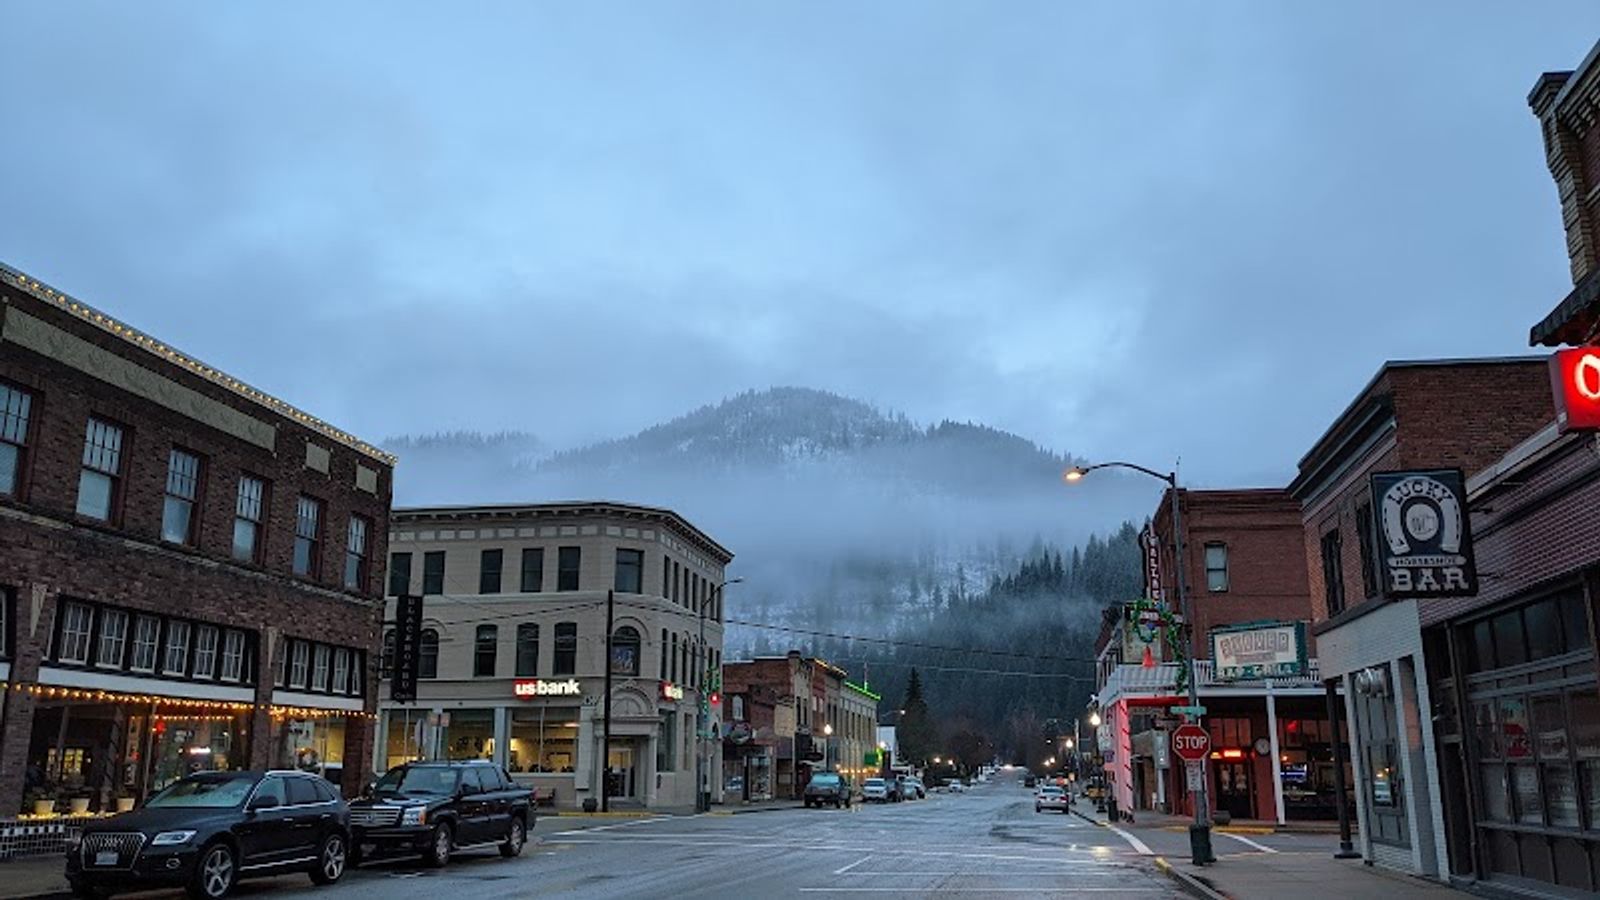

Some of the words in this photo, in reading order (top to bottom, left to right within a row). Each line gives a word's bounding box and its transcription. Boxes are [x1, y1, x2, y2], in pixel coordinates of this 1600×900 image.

[1388, 481, 1453, 505] LUCKY
[1395, 557, 1457, 566] HORSESHOE
[1390, 568, 1469, 591] BAR
[402, 597, 415, 689] BLACKBOARD
[1176, 736, 1207, 749] STOP
